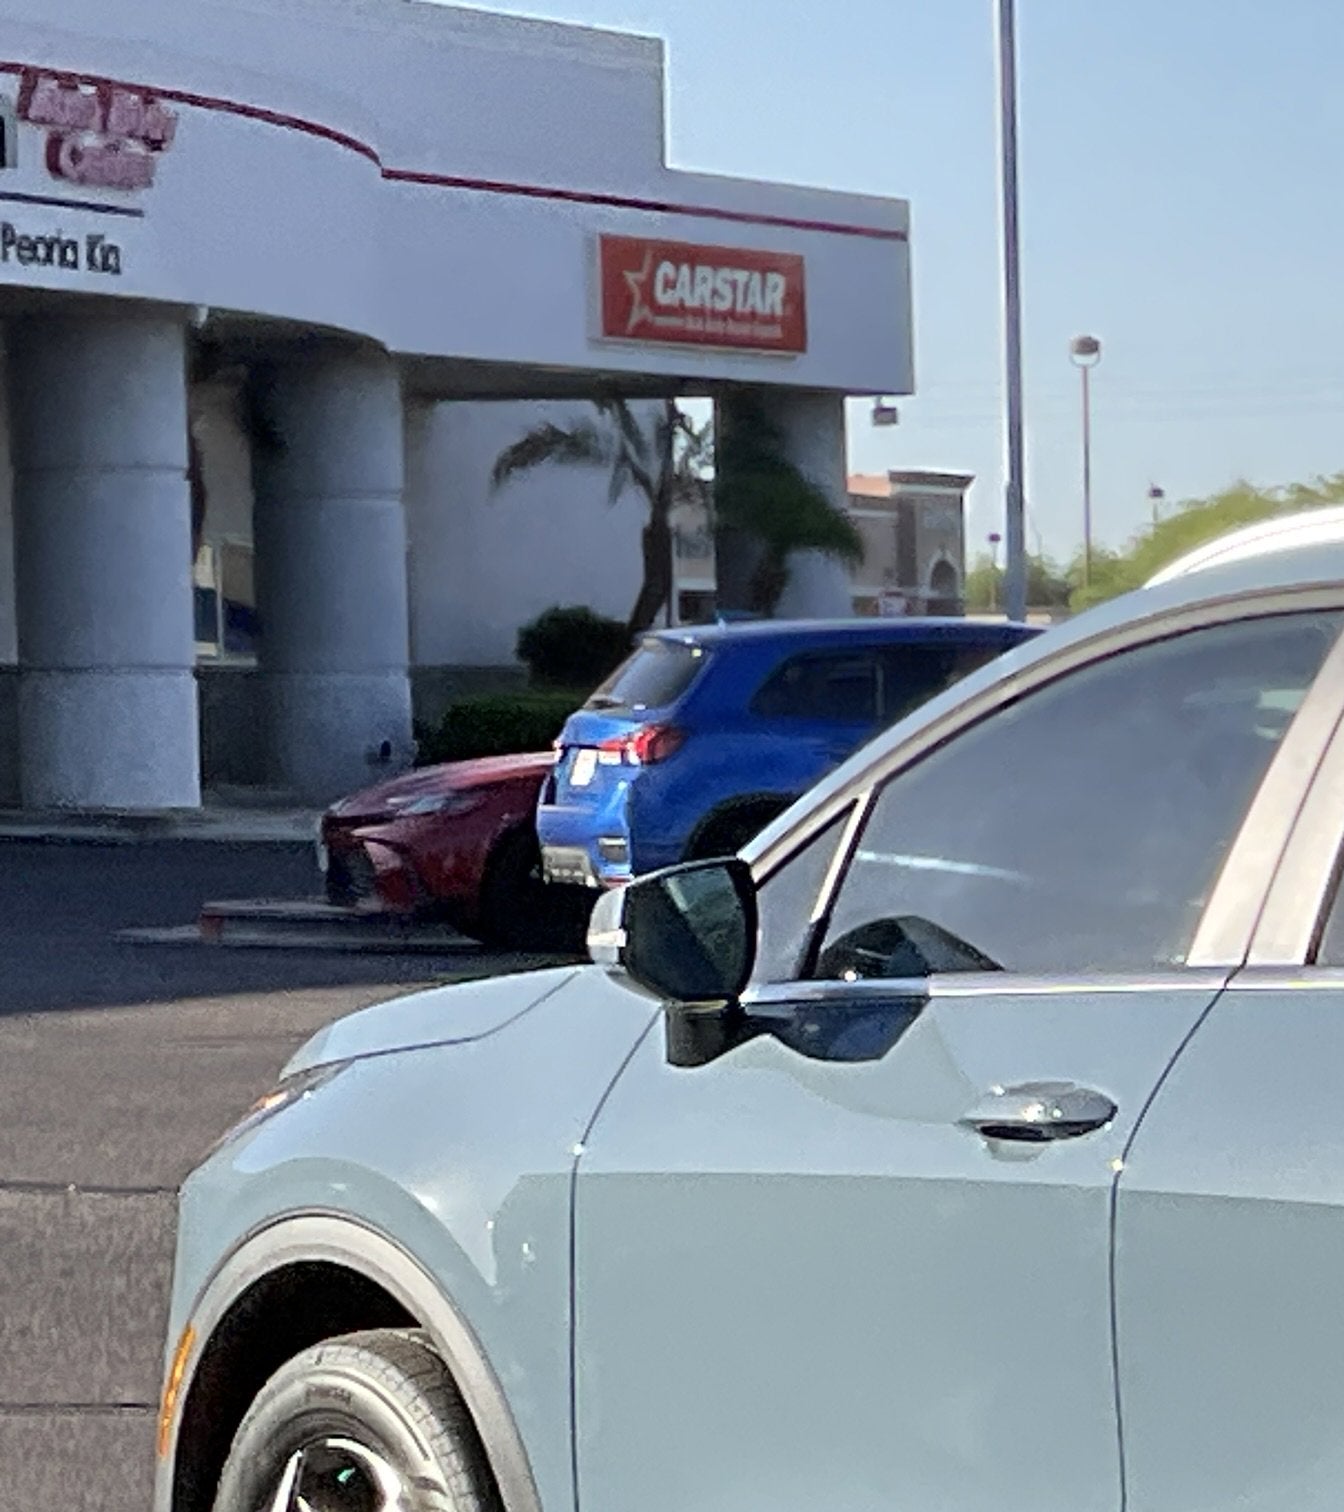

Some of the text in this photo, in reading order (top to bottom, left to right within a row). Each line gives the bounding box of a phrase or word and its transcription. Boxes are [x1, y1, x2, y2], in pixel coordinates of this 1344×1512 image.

[1, 221, 122, 276] Peoria Kia
[654, 260, 786, 316] CARSTAR
